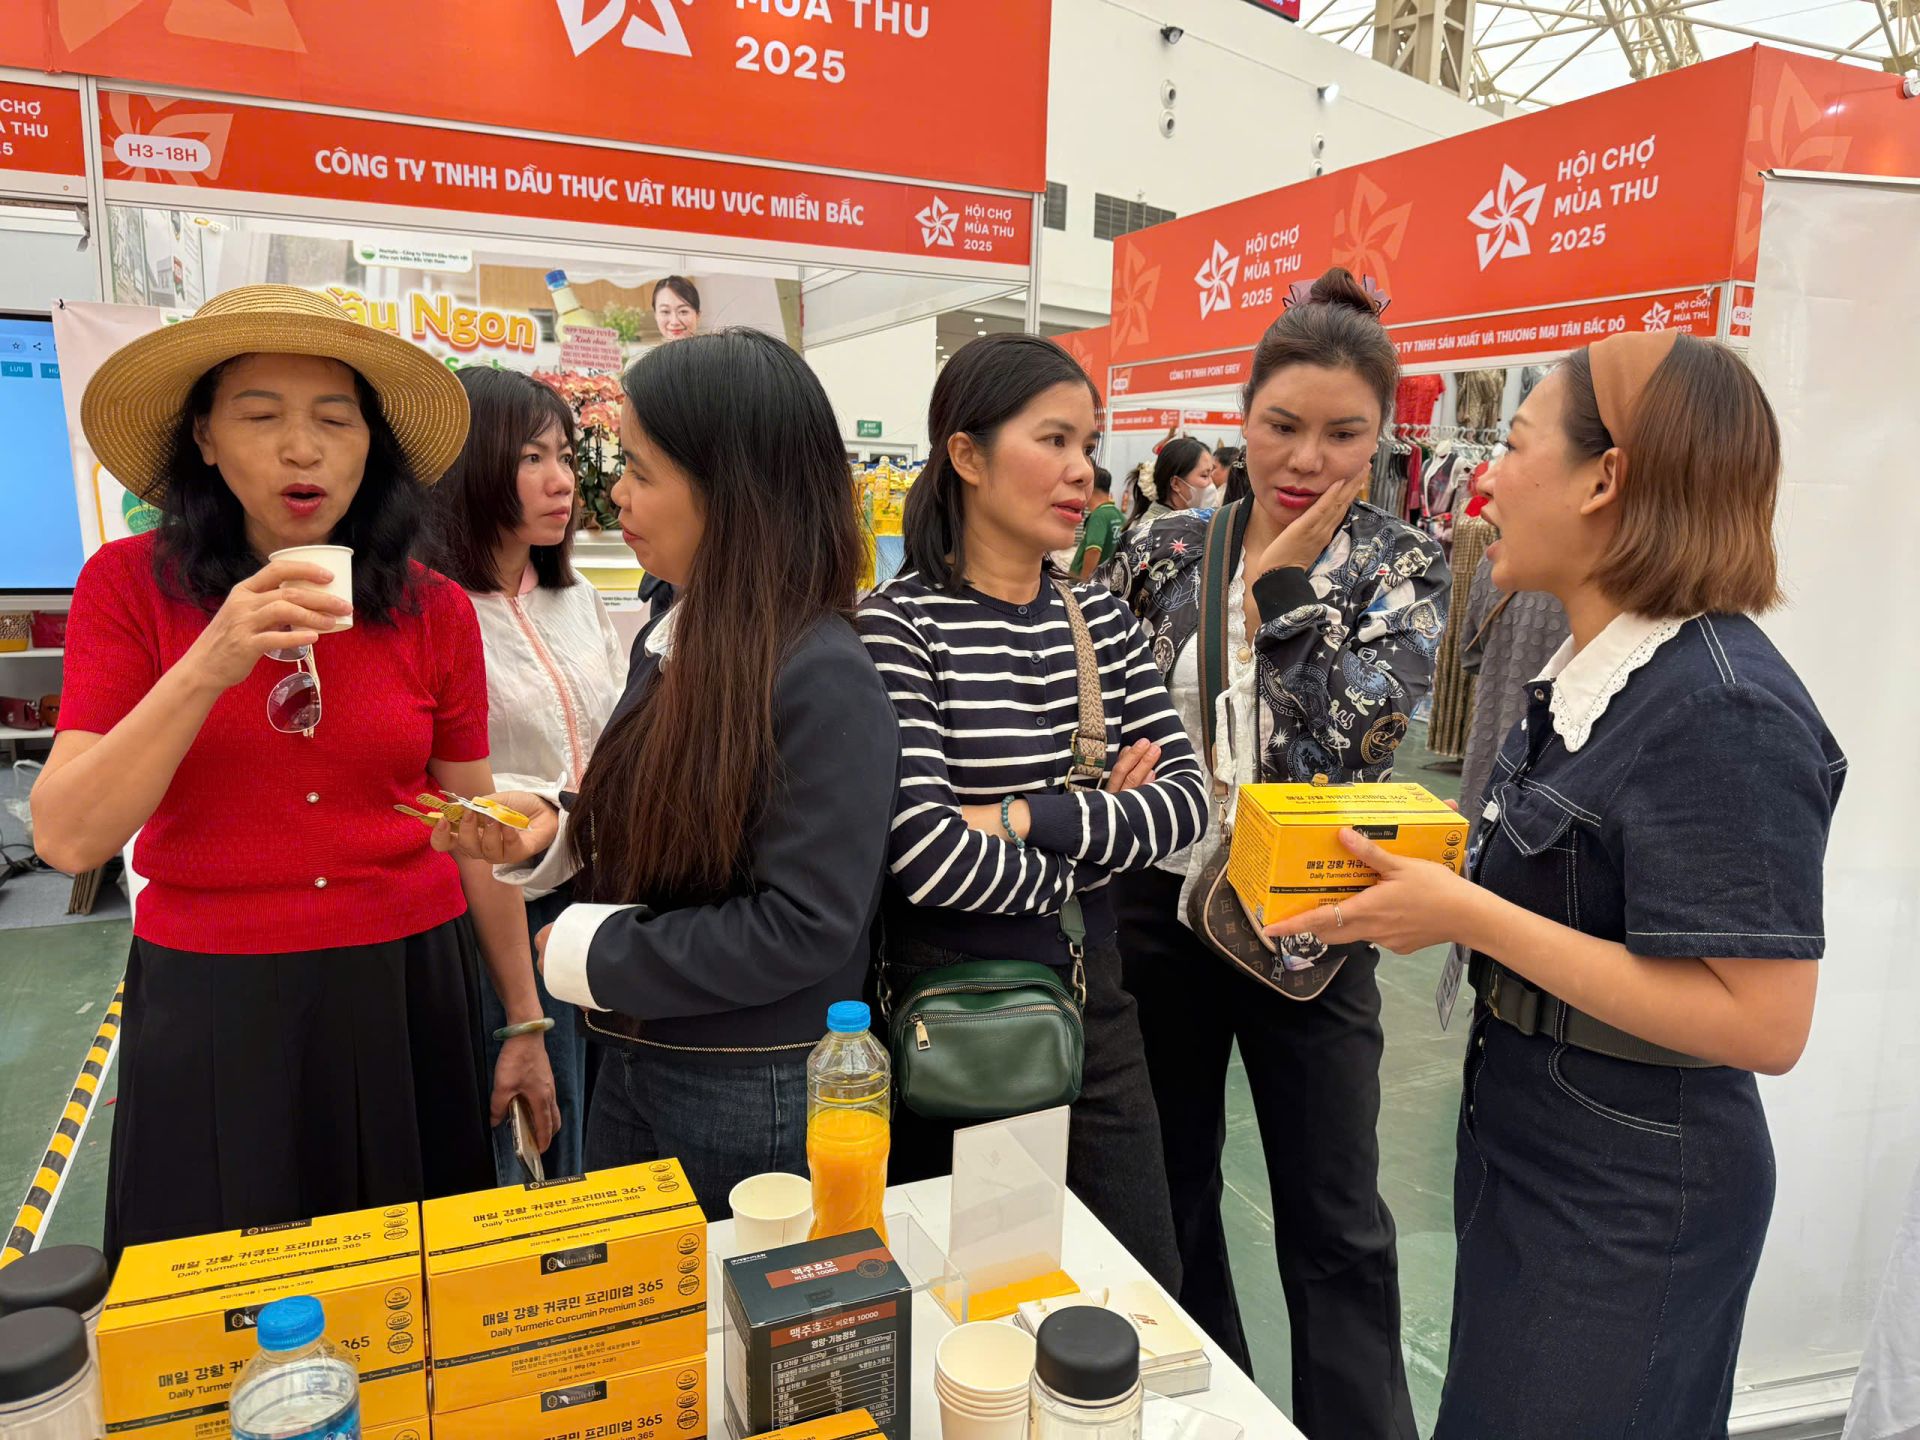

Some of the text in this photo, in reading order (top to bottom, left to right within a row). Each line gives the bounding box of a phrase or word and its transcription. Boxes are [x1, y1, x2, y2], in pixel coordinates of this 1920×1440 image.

[848, 0, 929, 38] THU
[735, 35, 845, 84] 2025
[0, 99, 41, 119] CHỢ
[11, 122, 48, 137] THU
[128, 143, 197, 162] H3-18H
[1557, 134, 1656, 183] HỘI CHỢ
[315, 146, 865, 226] CÔNG TY TNHH DẦU THỰC VẬT KHU VỰC MIỀN BẮC
[1553, 175, 1659, 218] MÙA THU
[965, 203, 1012, 223] HỘI CHỢ
[964, 220, 1015, 238] MÙA THU
[1245, 223, 1300, 257] HỘI CHỢ
[1549, 223, 1606, 254] 2025
[964, 239, 993, 252] 2025
[1243, 253, 1302, 282] MÙA THU
[1241, 287, 1273, 308] 2025
[1674, 300, 1689, 311] HỘI
[411, 291, 537, 353] Ngon
[1673, 310, 1710, 322] MÙA THU
[1402, 340, 1414, 353] TY
[1414, 336, 1436, 352] TNHH
[1457, 329, 1480, 348] XUẤT
[1482, 329, 1495, 345] VÀ
[1496, 326, 1537, 344] THƯƠNG
[1539, 322, 1559, 340] MẠI
[1560, 318, 1581, 337] TÂN
[1583, 315, 1606, 334] BẮC
[1307, 860, 1344, 870] 매일 강황
[474, 1185, 646, 1222] 매일 강황 커큐민 프리미엄 365
[482, 1194, 641, 1229] Daily Turmeric Curcumin Premium 365
[171, 1232, 372, 1272] 매일 강황 커큐민 프리미엄 365
[177, 1242, 361, 1279] Daily Turmeric Curcumin Premium 365
[588, 1253, 602, 1261] Bio
[791, 1260, 835, 1275] 맥주효모
[794, 1267, 839, 1281] 비오틴 10000
[483, 1310, 509, 1327] 매일
[513, 1304, 540, 1321] 강황
[543, 1295, 581, 1314] 커큐민
[584, 1284, 634, 1306] 프리미엄
[638, 1278, 664, 1294] 365
[490, 1296, 655, 1339] Daily Turmeric Curcumin Premium 365
[789, 1311, 879, 1339] 맥주효모 비오틴 10000
[811, 1330, 857, 1349] 영양·기능정보
[159, 1370, 189, 1388] 매일
[194, 1364, 224, 1380] 강황
[169, 1380, 233, 1400] Daily Turmer
[585, 1413, 663, 1440] 프리미엄 365
[638, 1430, 655, 1440] 365
